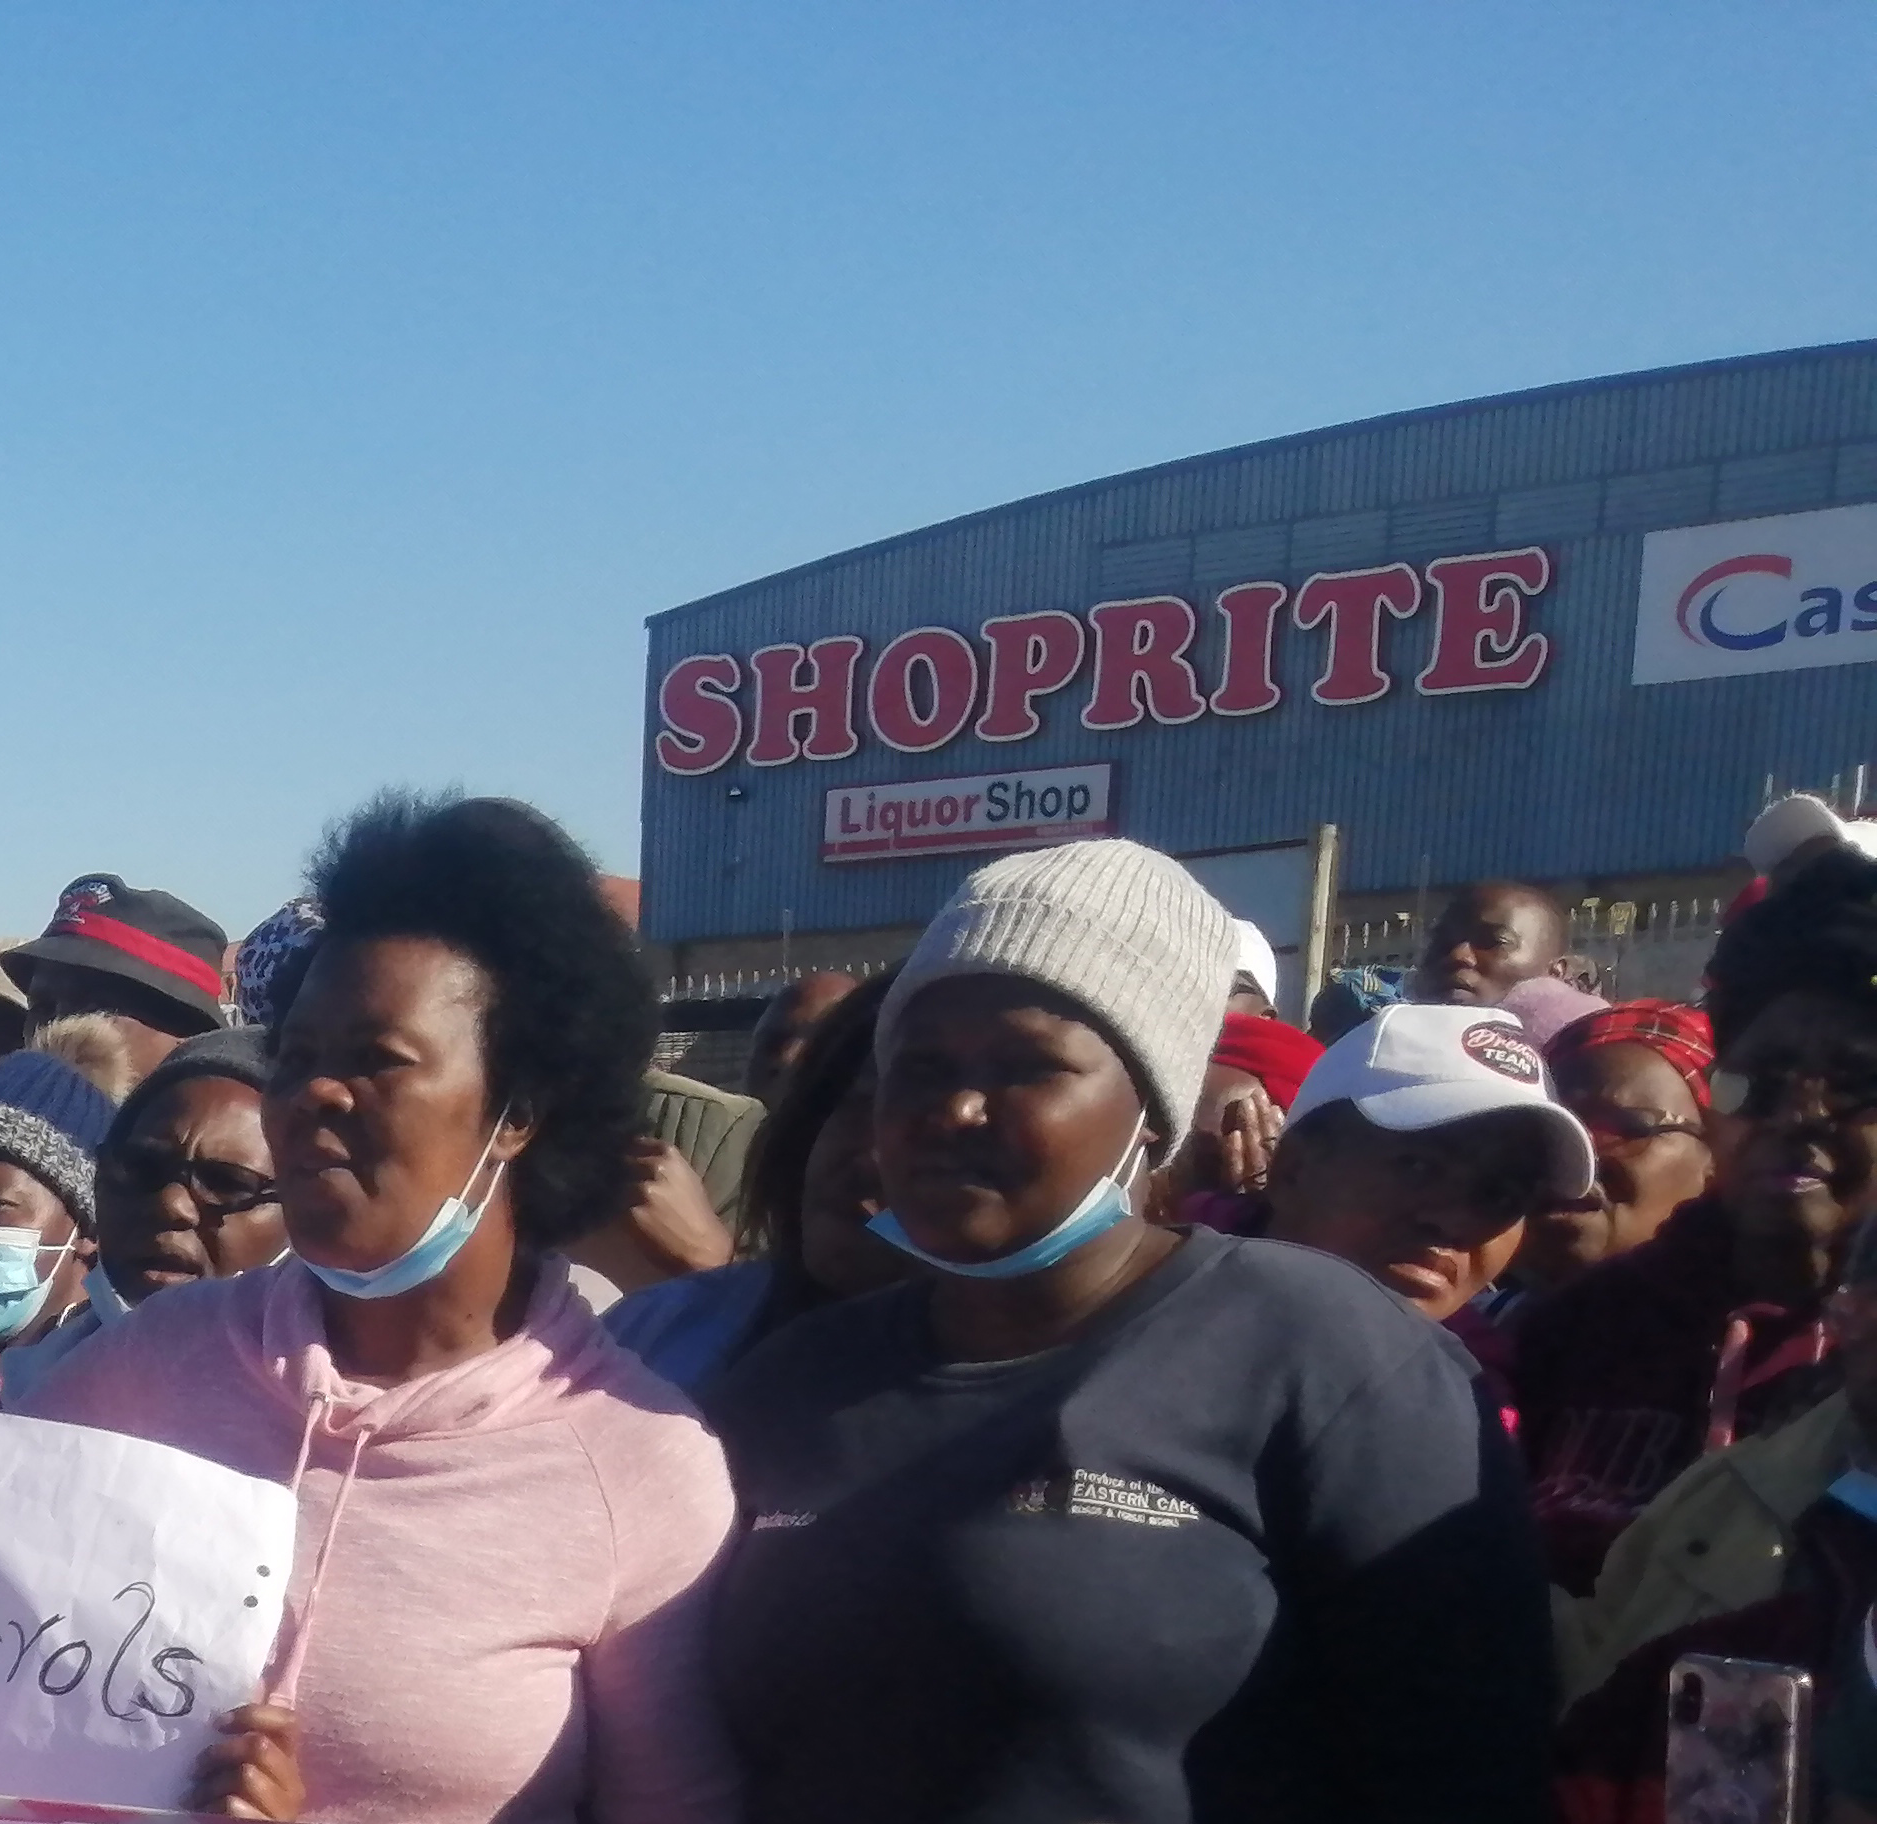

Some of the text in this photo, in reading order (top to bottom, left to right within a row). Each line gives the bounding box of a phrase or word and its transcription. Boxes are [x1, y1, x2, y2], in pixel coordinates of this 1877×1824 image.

[655, 545, 1552, 777] SHOPRITE
[1483, 1047, 1531, 1075] TEAM
[1073, 1483, 1150, 1508] EASTERN
